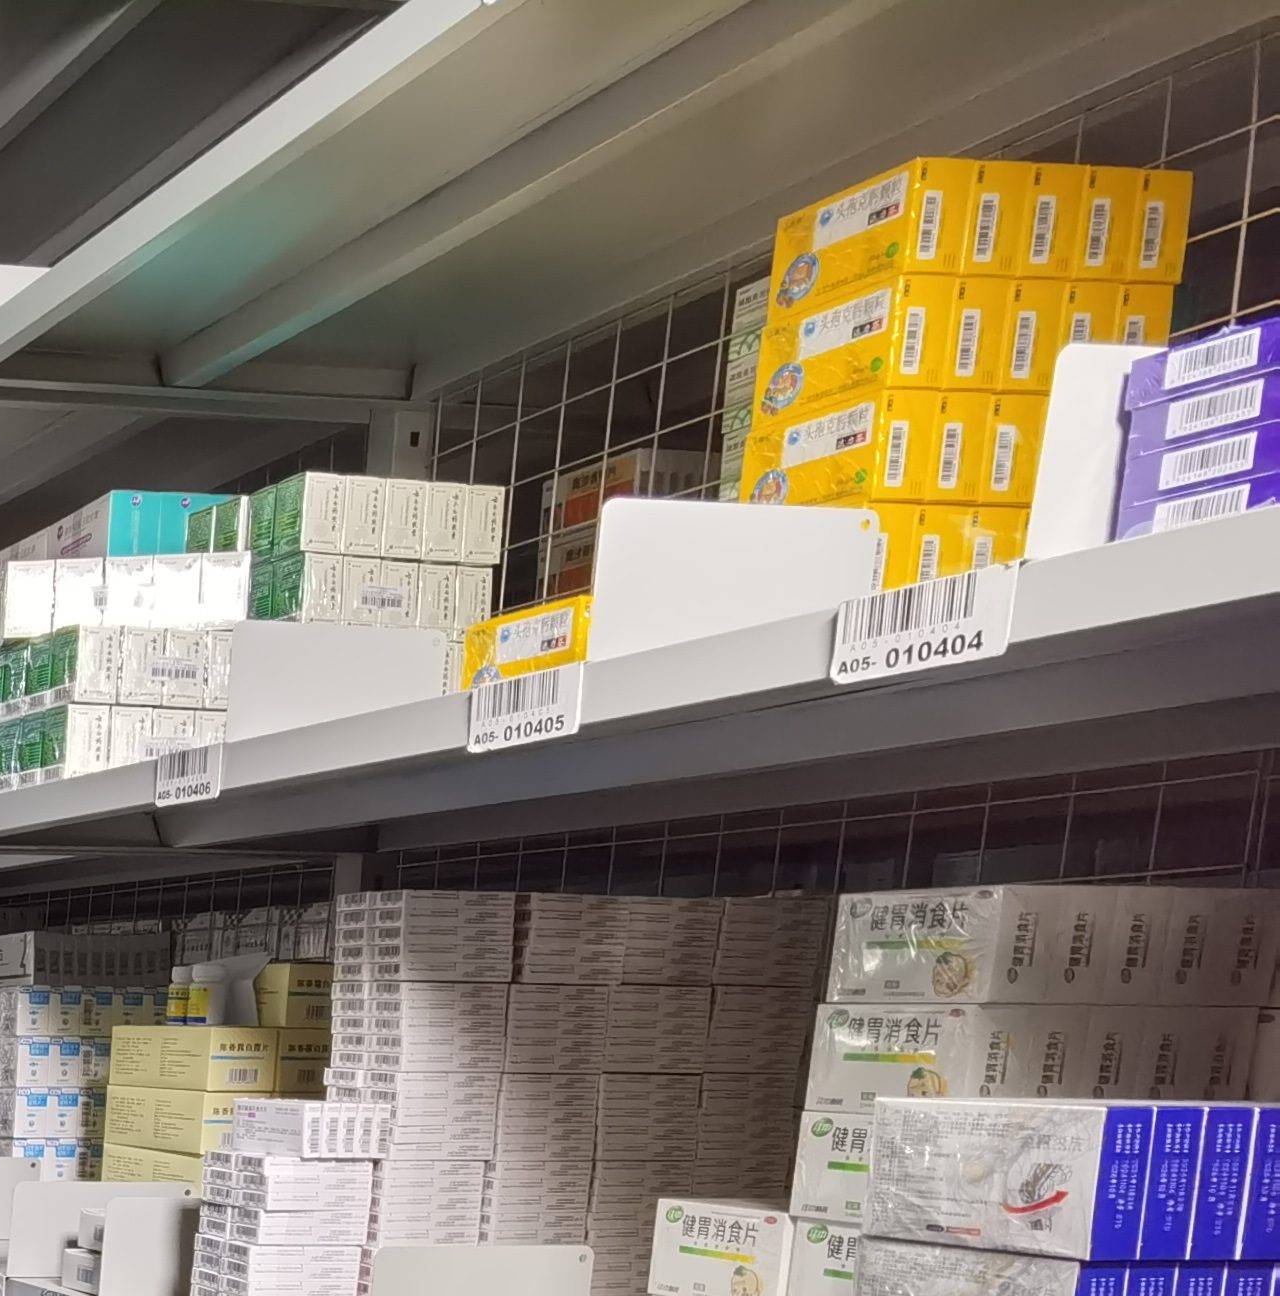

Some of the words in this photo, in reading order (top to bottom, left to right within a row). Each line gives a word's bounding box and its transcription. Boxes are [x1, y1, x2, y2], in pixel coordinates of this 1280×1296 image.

[837, 656, 877, 675] A05-
[885, 629, 984, 669] 010404
[474, 732, 499, 746] A05-
[504, 714, 565, 742] 010405
[175, 782, 211, 799] 010406
[870, 898, 968, 931] 健胃消食片
[848, 1016, 942, 1046] 健胃消食片
[682, 1213, 760, 1248] 健胃消食片
